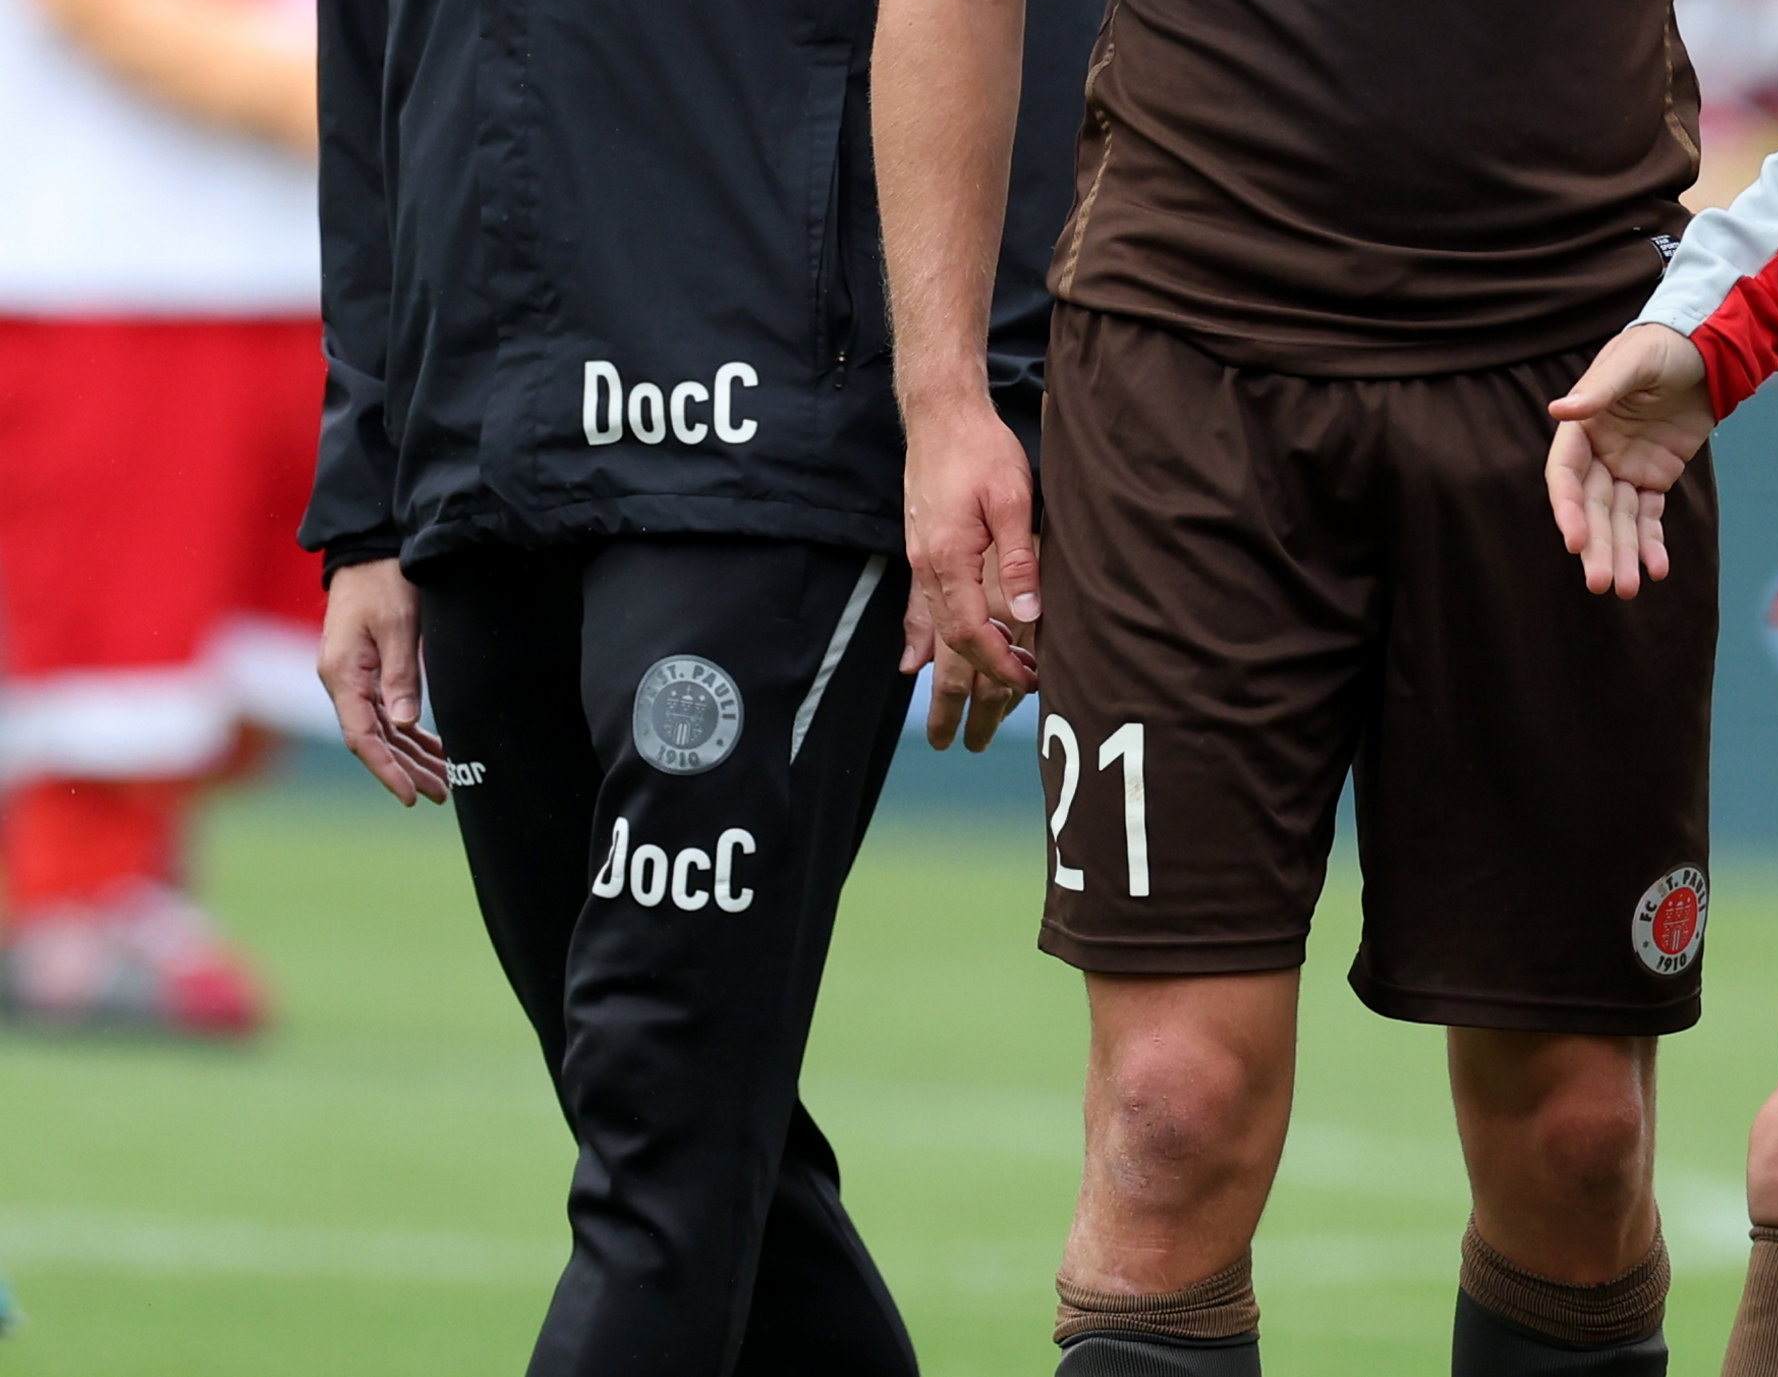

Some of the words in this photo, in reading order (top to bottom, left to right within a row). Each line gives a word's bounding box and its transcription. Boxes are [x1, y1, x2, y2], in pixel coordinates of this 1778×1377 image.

[582, 360, 759, 446] DocC
[692, 664, 737, 720] PAULI
[657, 745, 699, 767] 1910
[1041, 712, 1151, 898] 21
[591, 816, 757, 913] DocC
[1639, 900, 1657, 922] FC
[1683, 869, 1706, 913] PAULI
[1656, 952, 1688, 973] 1910
